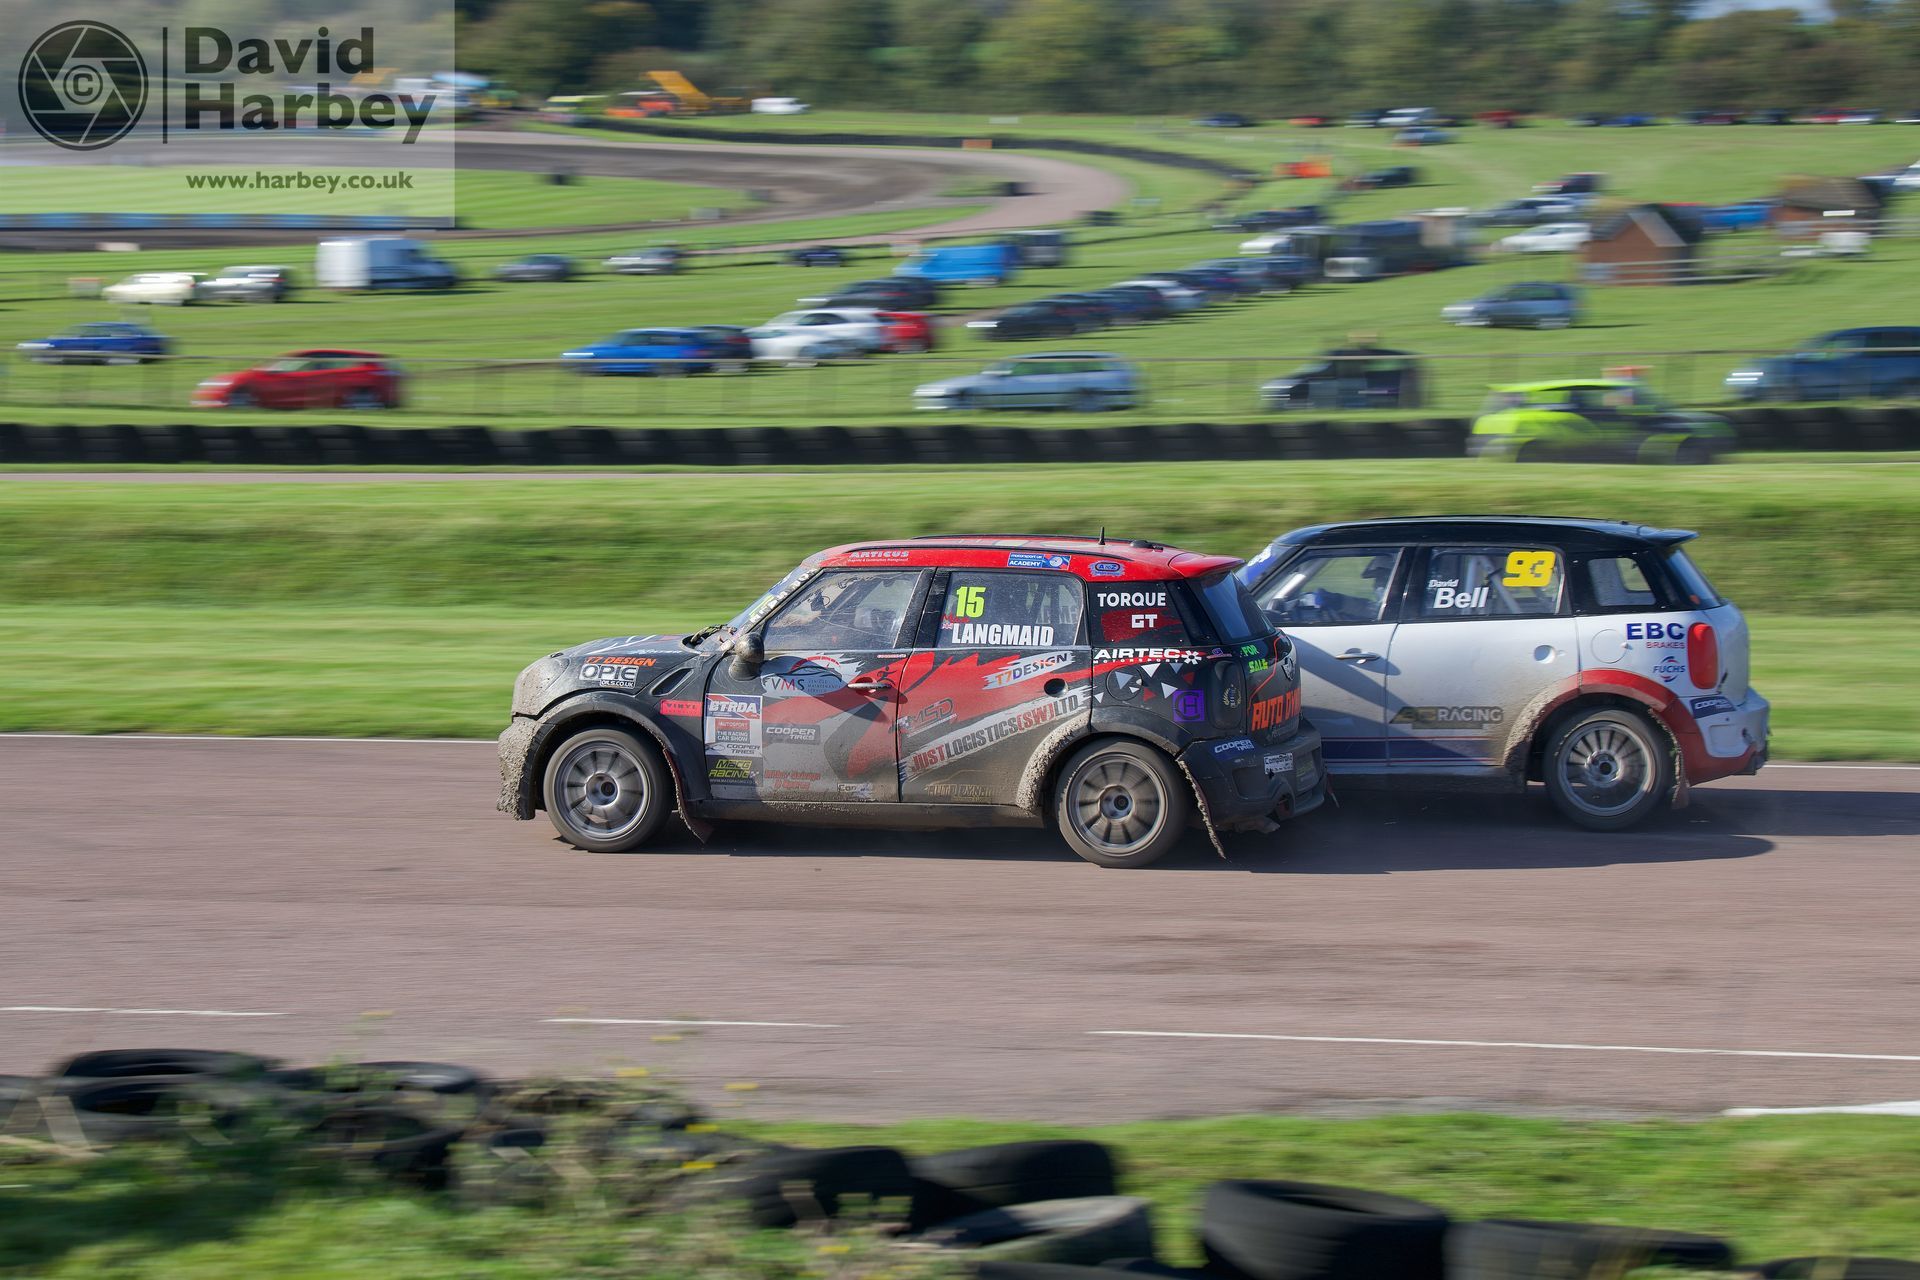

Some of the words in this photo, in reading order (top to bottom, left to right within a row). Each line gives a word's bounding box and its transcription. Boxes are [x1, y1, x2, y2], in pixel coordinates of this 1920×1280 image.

[1502, 551, 1557, 587] 93
[1429, 579, 1460, 588] David
[956, 586, 986, 618] 15
[1097, 592, 1166, 607] TORQUE
[1433, 587, 1489, 608] Bell
[1131, 614, 1158, 628] GT
[951, 623, 1054, 646] LANGMAID
[1626, 622, 1686, 640] EBC
[1241, 645, 1260, 657] FOR
[1646, 641, 1686, 649] BRAKES
[1094, 648, 1181, 660] AIRTEC
[603, 657, 657, 667] DESIGN
[1248, 658, 1269, 673] SALE
[1652, 665, 1686, 673] FUCHS
[581, 664, 637, 680] OPIE
[771, 678, 805, 691] VMS
[708, 700, 757, 713] BTRDA
[1252, 695, 1284, 731] AUTO
[1437, 708, 1503, 722] RACING
[766, 727, 816, 735] COOPER
[1214, 739, 1252, 753] COOPER
